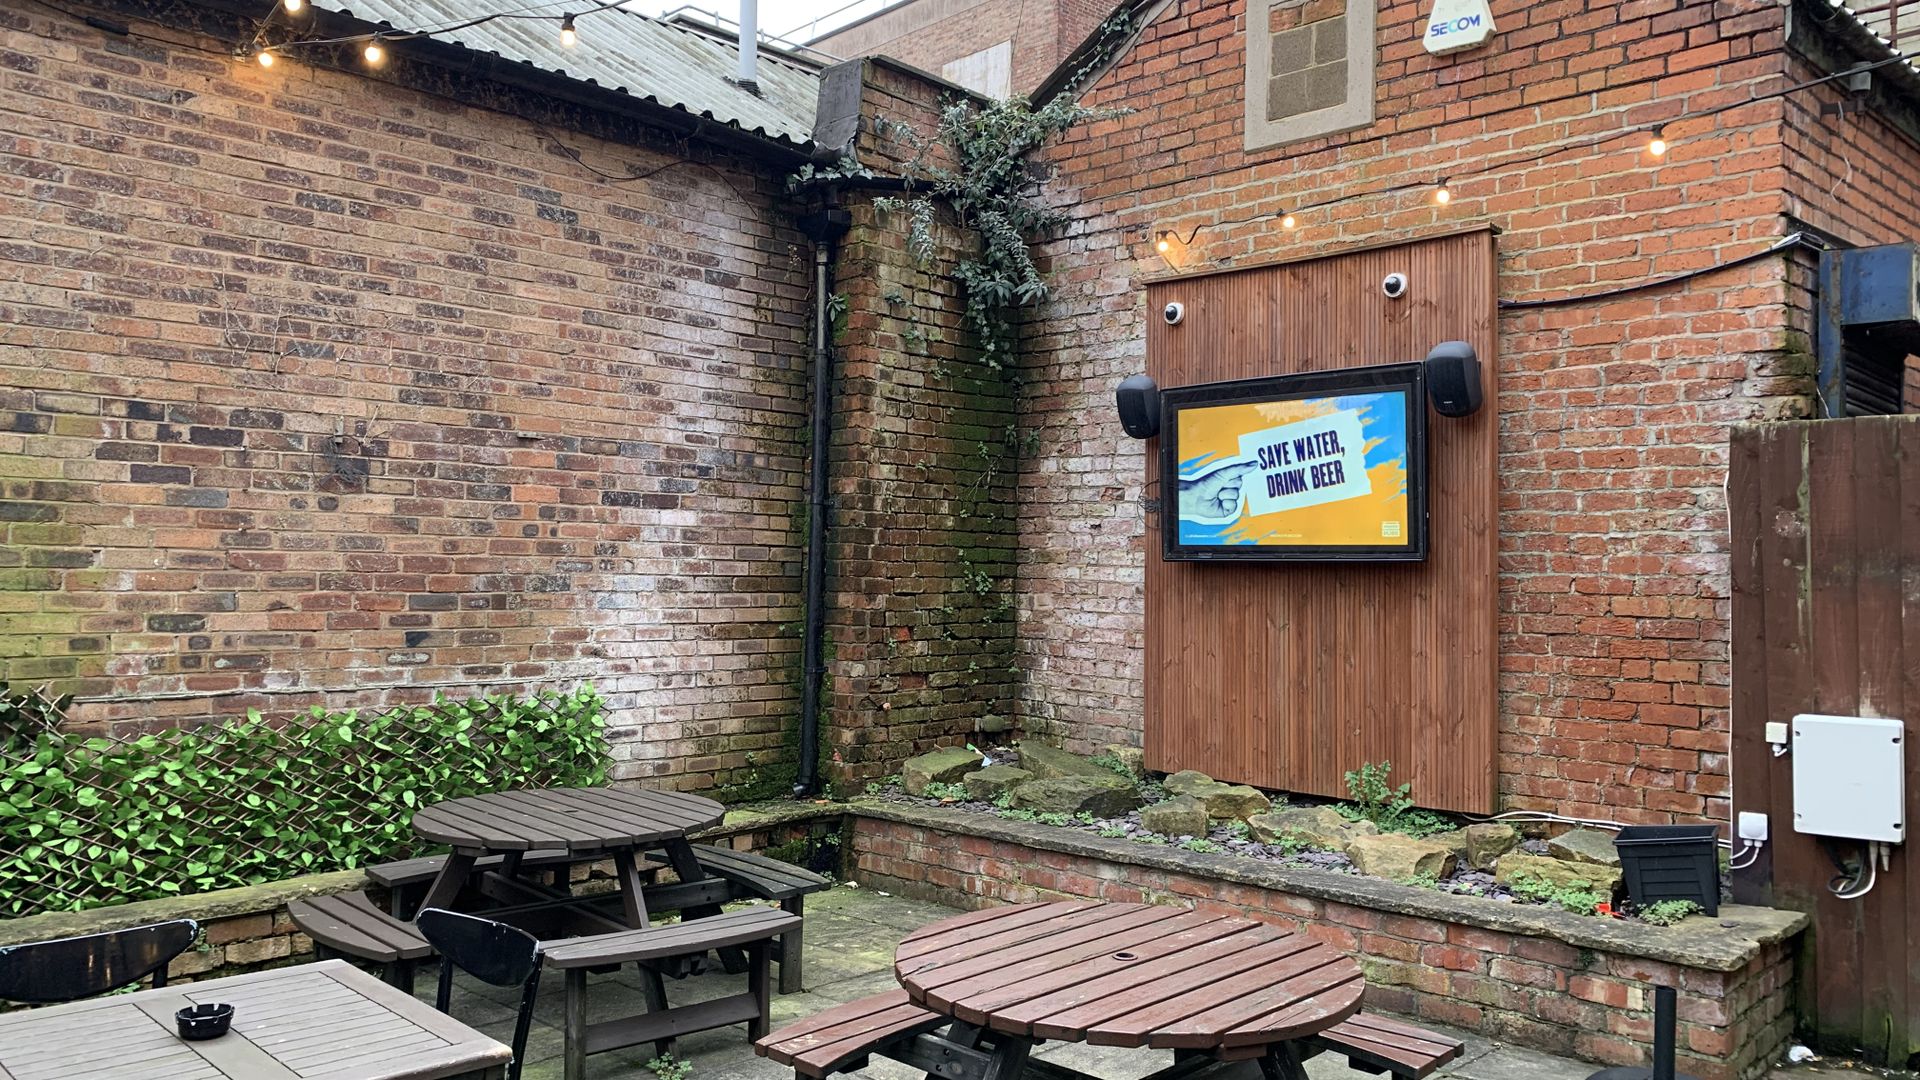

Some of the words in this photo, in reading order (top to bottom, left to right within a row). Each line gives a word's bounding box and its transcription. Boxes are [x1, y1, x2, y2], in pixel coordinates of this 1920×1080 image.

[1430, 14, 1481, 37] SECOM
[1257, 441, 1292, 471] SAVE
[1293, 429, 1346, 463] WATER,
[1266, 467, 1309, 499] DRINK
[1310, 459, 1346, 490] BEER
